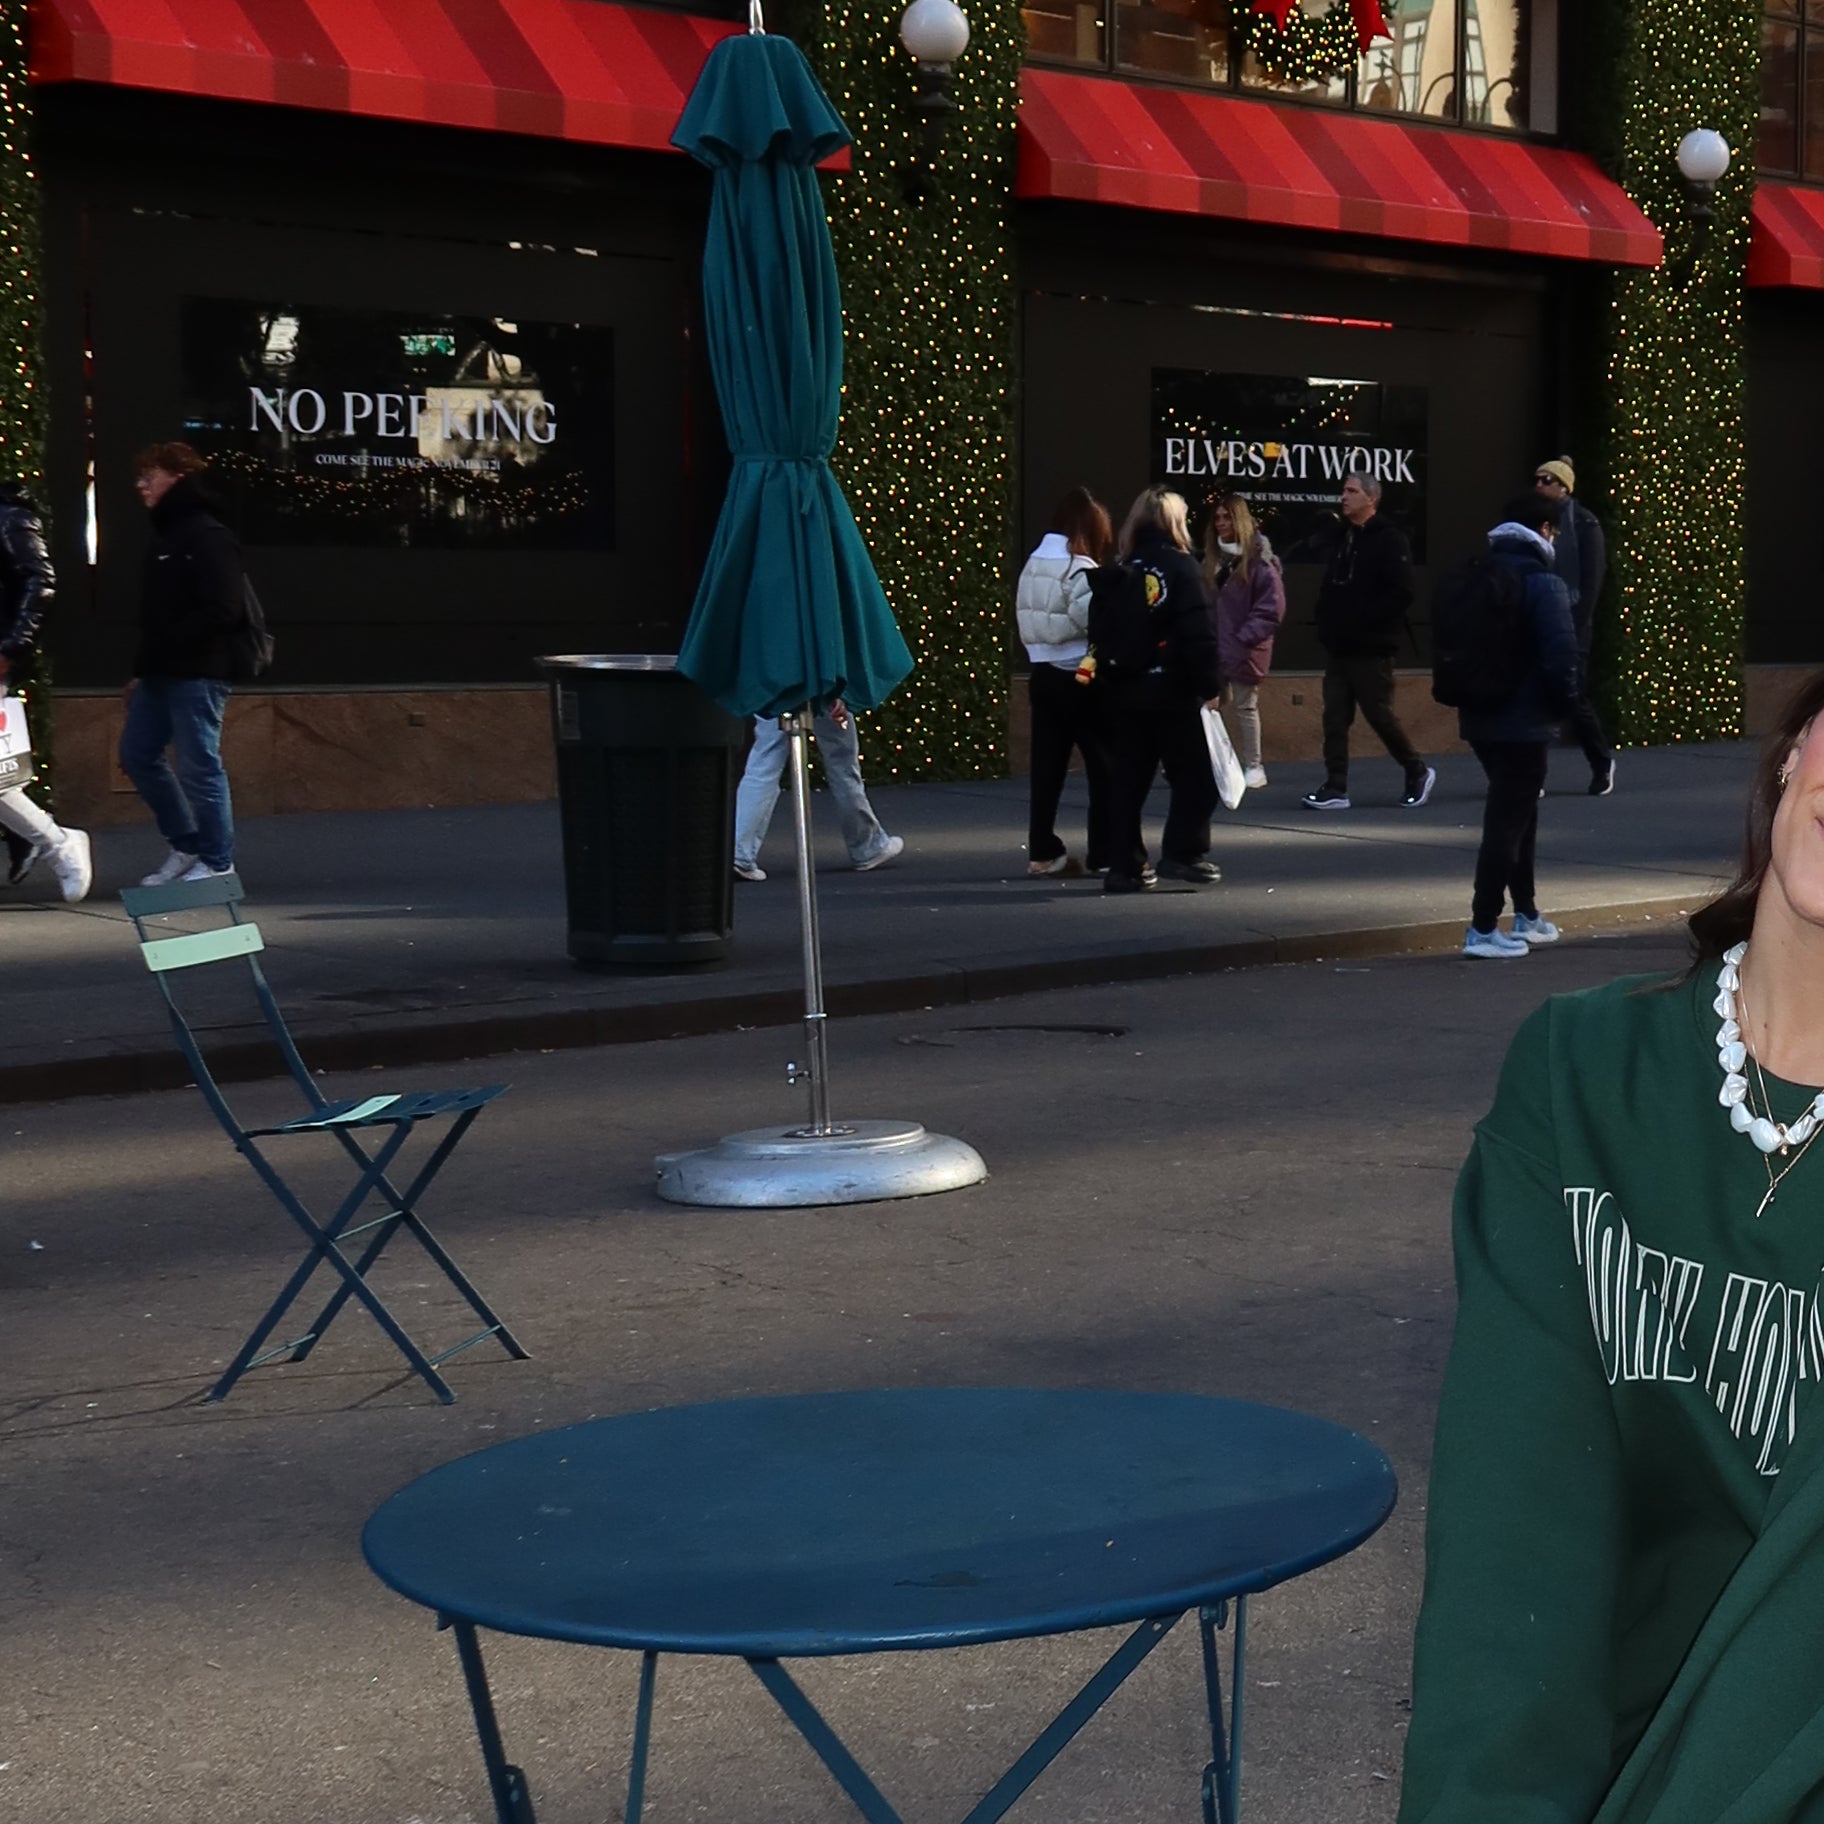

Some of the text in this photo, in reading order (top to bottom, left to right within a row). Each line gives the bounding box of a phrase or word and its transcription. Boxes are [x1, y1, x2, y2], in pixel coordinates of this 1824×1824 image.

[248, 386, 558, 445] NO PEEKING
[315, 454, 348, 467] COME
[372, 455, 394, 468] THE
[1165, 437, 1415, 484] ELVES AT WORK
